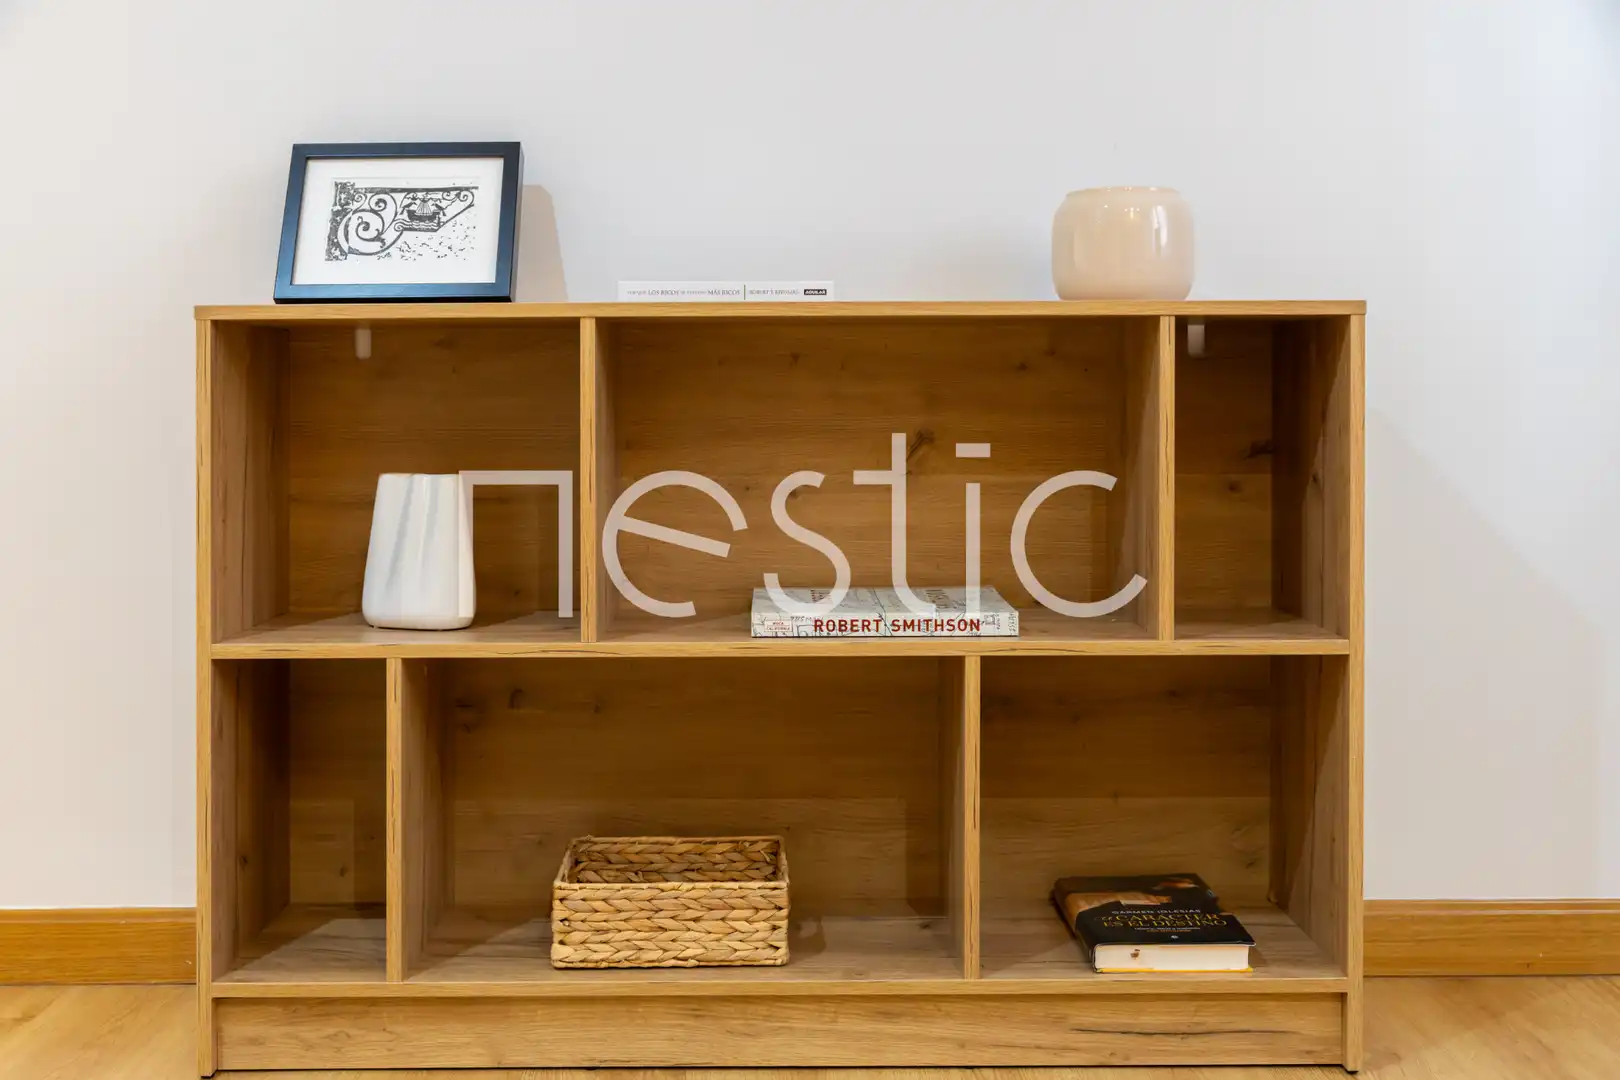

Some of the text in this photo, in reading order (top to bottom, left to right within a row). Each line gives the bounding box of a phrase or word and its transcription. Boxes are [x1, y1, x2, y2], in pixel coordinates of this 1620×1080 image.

[813, 618, 882, 633] ROBERT
[891, 618, 981, 633] SMITHSON
[1153, 919, 1227, 927] DESTINO
